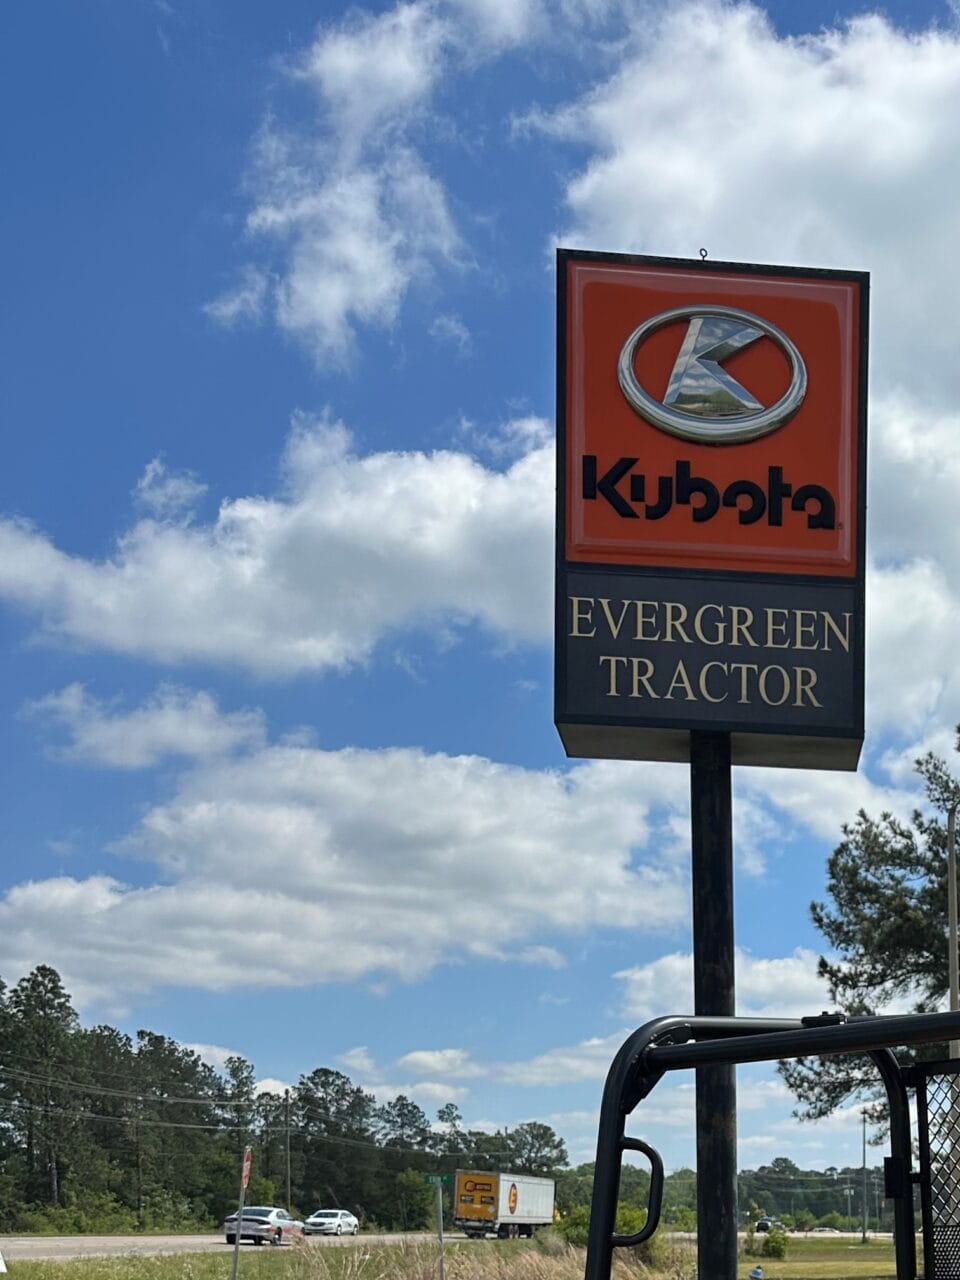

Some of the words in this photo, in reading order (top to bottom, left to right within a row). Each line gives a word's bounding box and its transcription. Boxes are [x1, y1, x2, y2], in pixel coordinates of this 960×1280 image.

[581, 454, 837, 530] Kubota
[567, 596, 854, 654] EVERGREEN
[599, 655, 824, 708] TRACTOR
